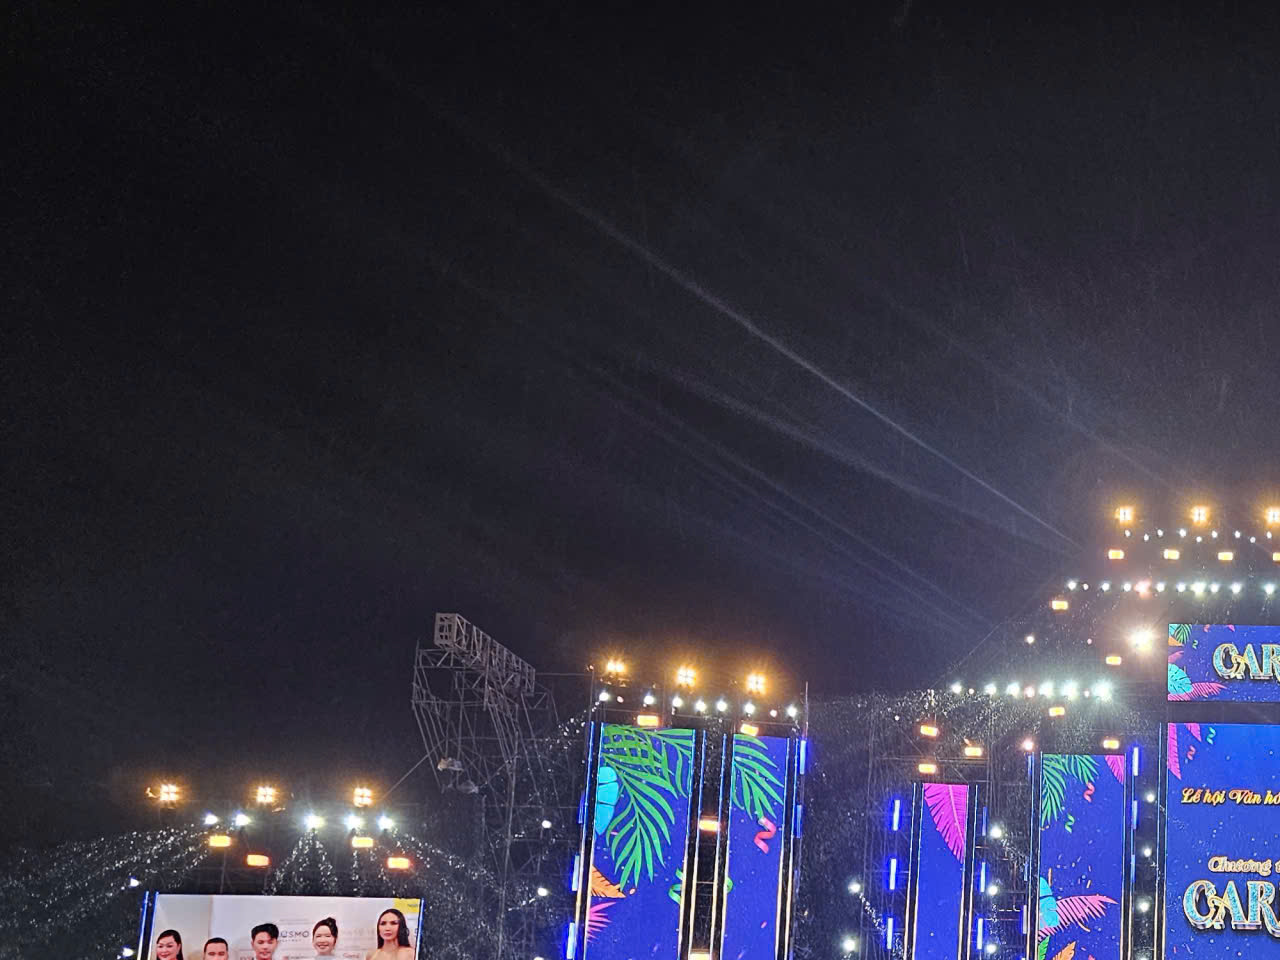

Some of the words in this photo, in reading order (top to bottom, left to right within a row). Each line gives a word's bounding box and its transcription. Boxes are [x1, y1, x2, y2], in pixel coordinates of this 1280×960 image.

[1181, 787, 1203, 804] Lễ
[1203, 789, 1226, 806] hội
[1228, 789, 1262, 805] Văn
[1208, 856, 1272, 876] Chương
